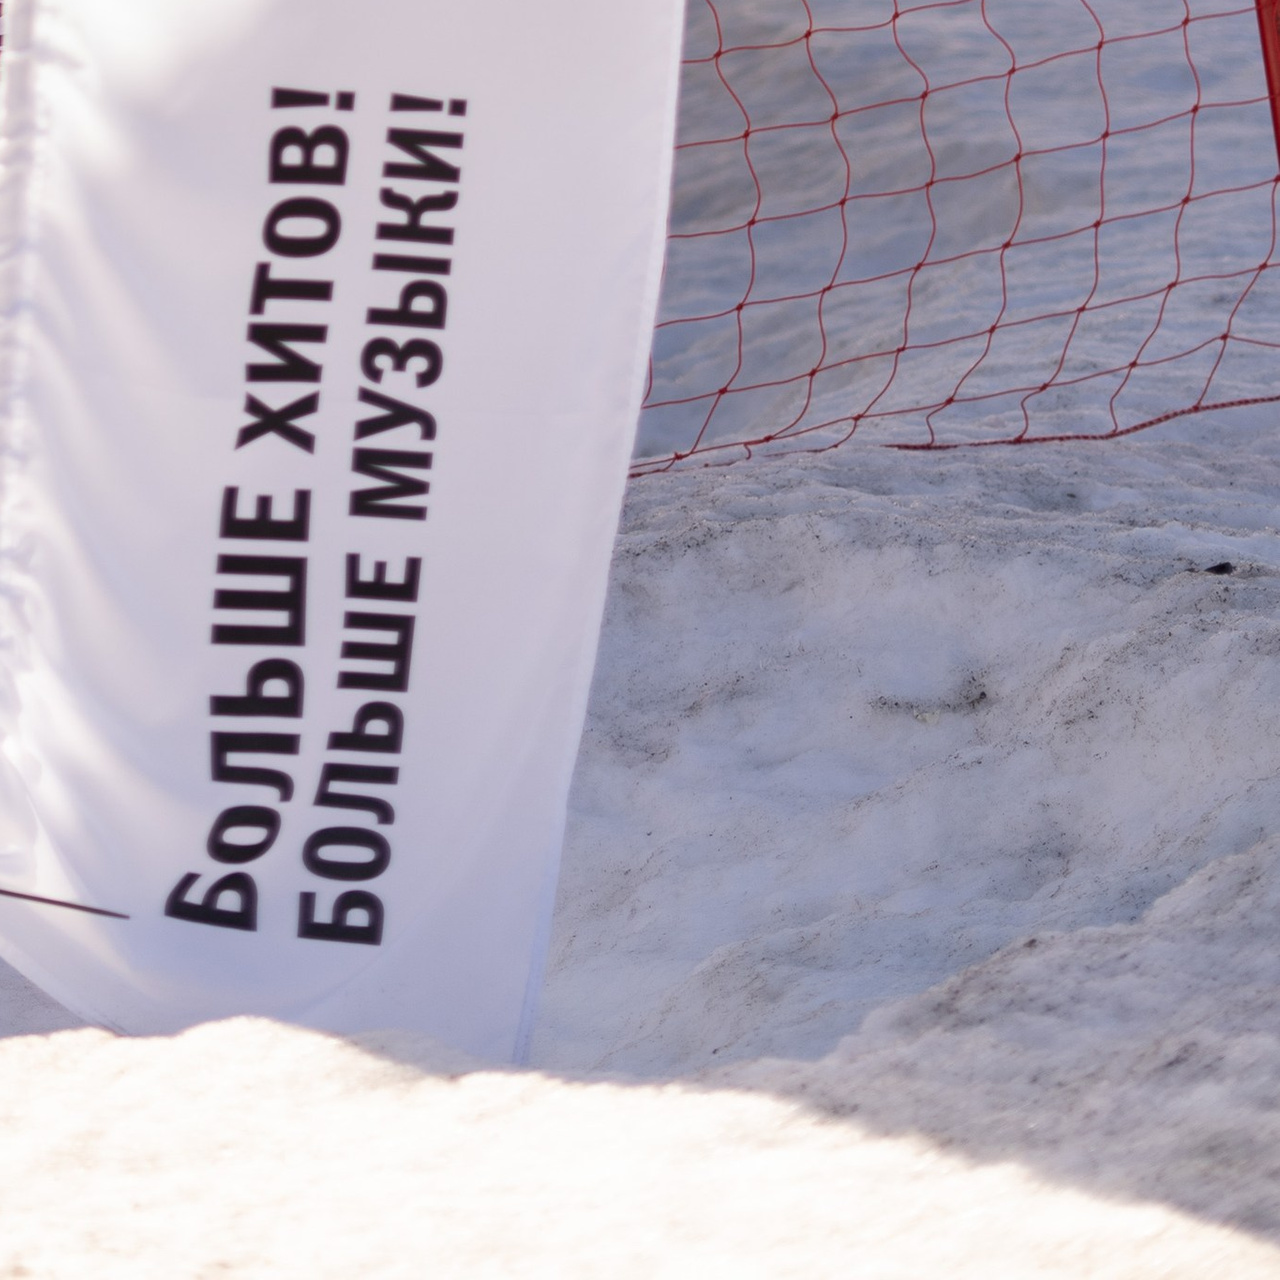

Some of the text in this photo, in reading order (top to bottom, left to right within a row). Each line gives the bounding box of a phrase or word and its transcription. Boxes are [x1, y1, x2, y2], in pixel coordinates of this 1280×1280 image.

[164, 87, 356, 932] БОЛЬШЕ ХИТОВ!
[296, 92, 468, 946] БОЛЬШЕ МУЗЫКИ!
